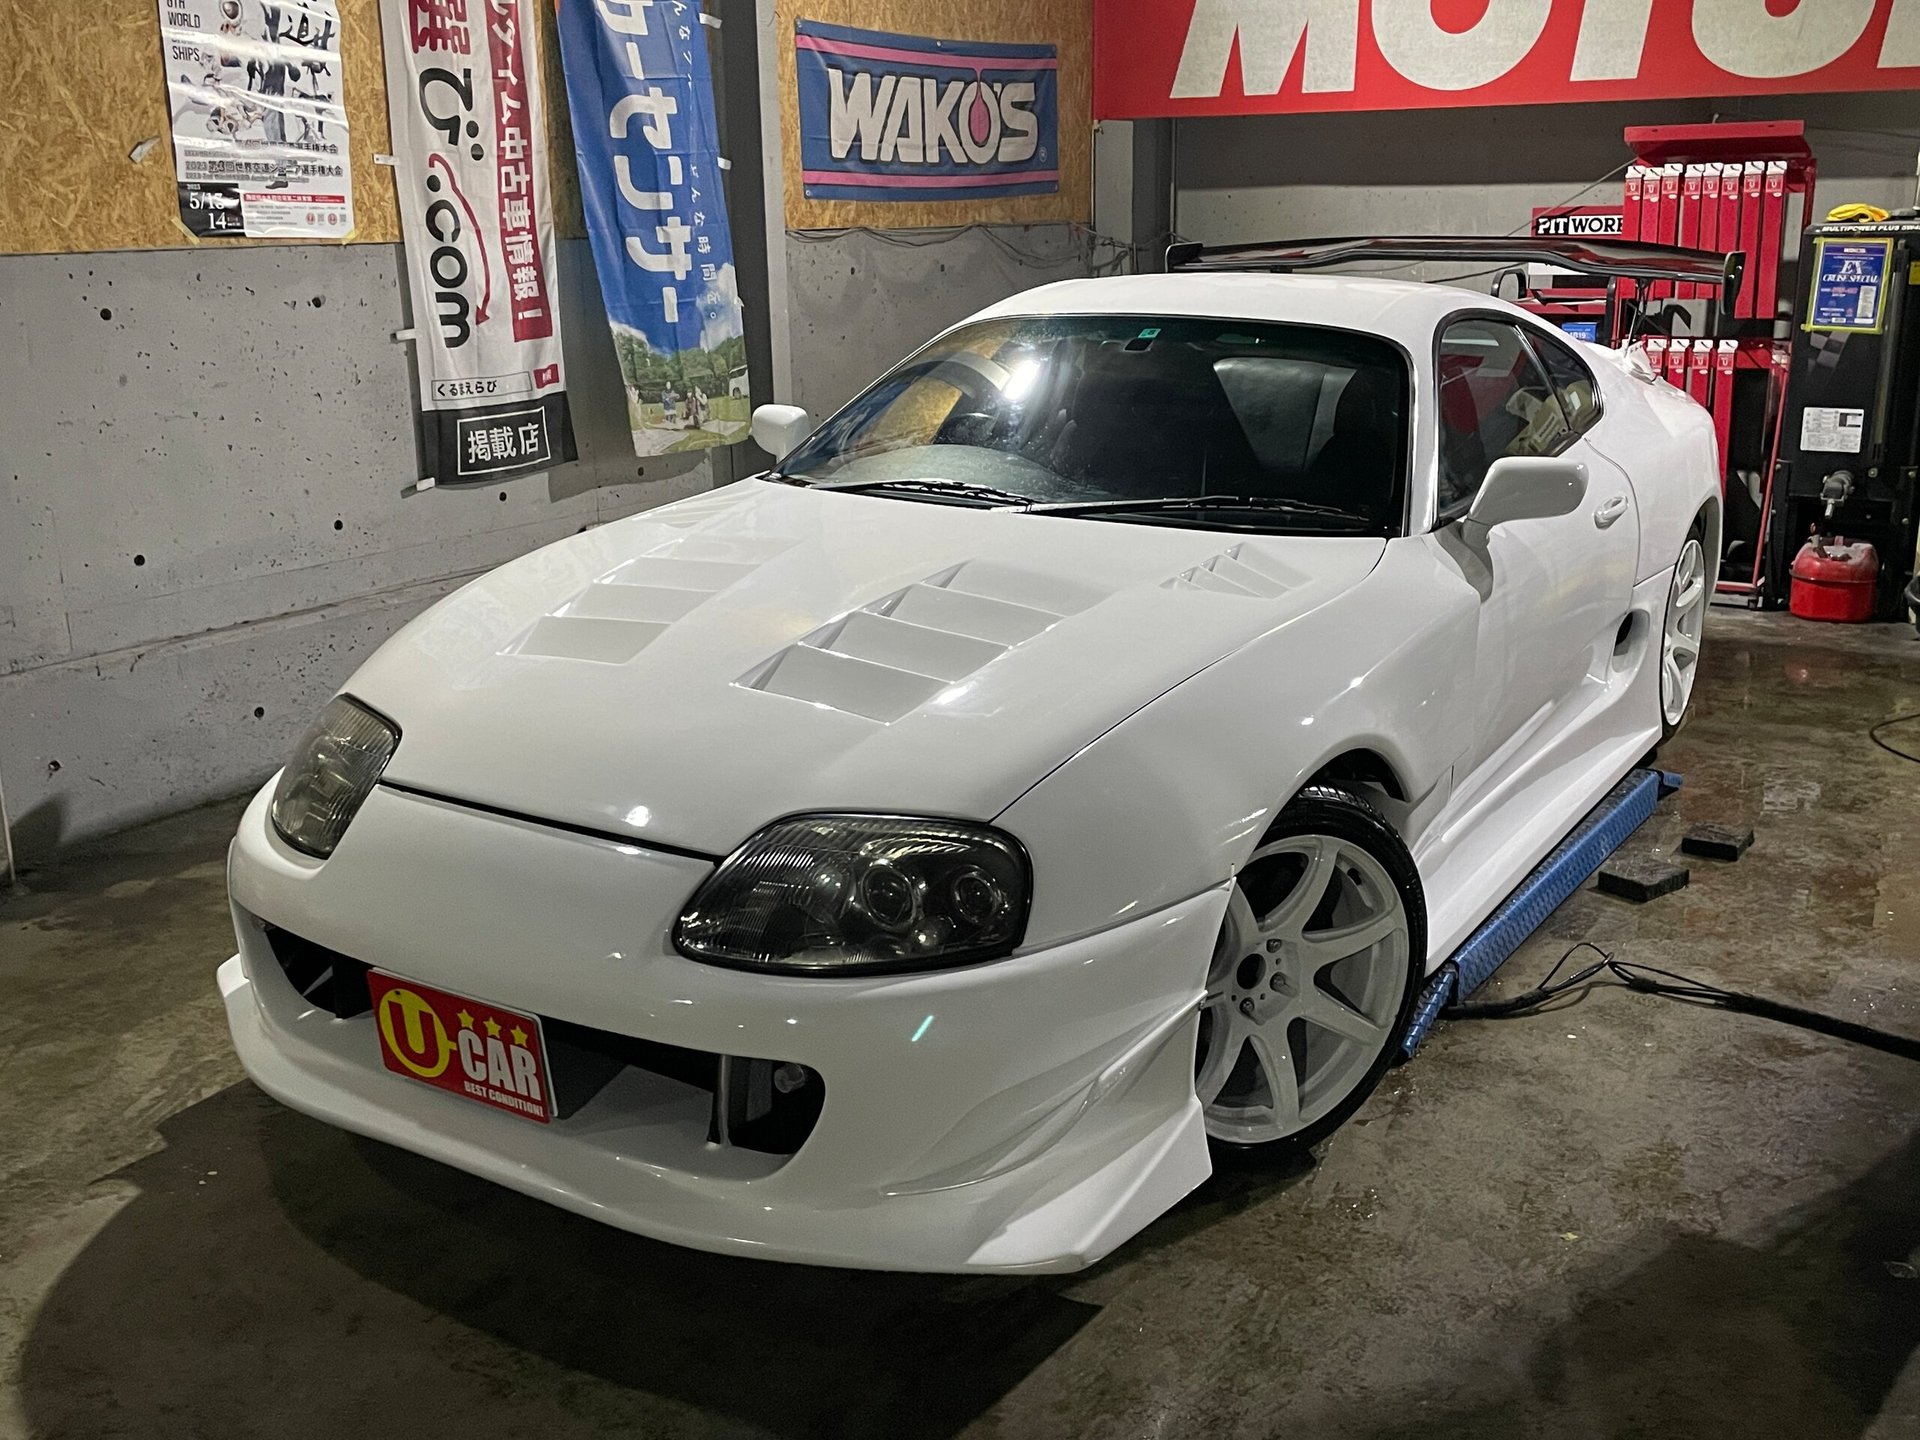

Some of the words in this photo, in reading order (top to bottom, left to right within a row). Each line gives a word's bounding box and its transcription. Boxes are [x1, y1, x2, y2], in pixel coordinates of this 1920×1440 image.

[168, 11, 200, 28] WORLD
[172, 45, 200, 61] SHIPS
[828, 68, 1038, 165] WAKO'S
[209, 212, 227, 229] 14
[437, 380, 498, 397] くるまえらび
[468, 423, 540, 464] 掲載店
[464, 1080, 489, 1098] BEST
